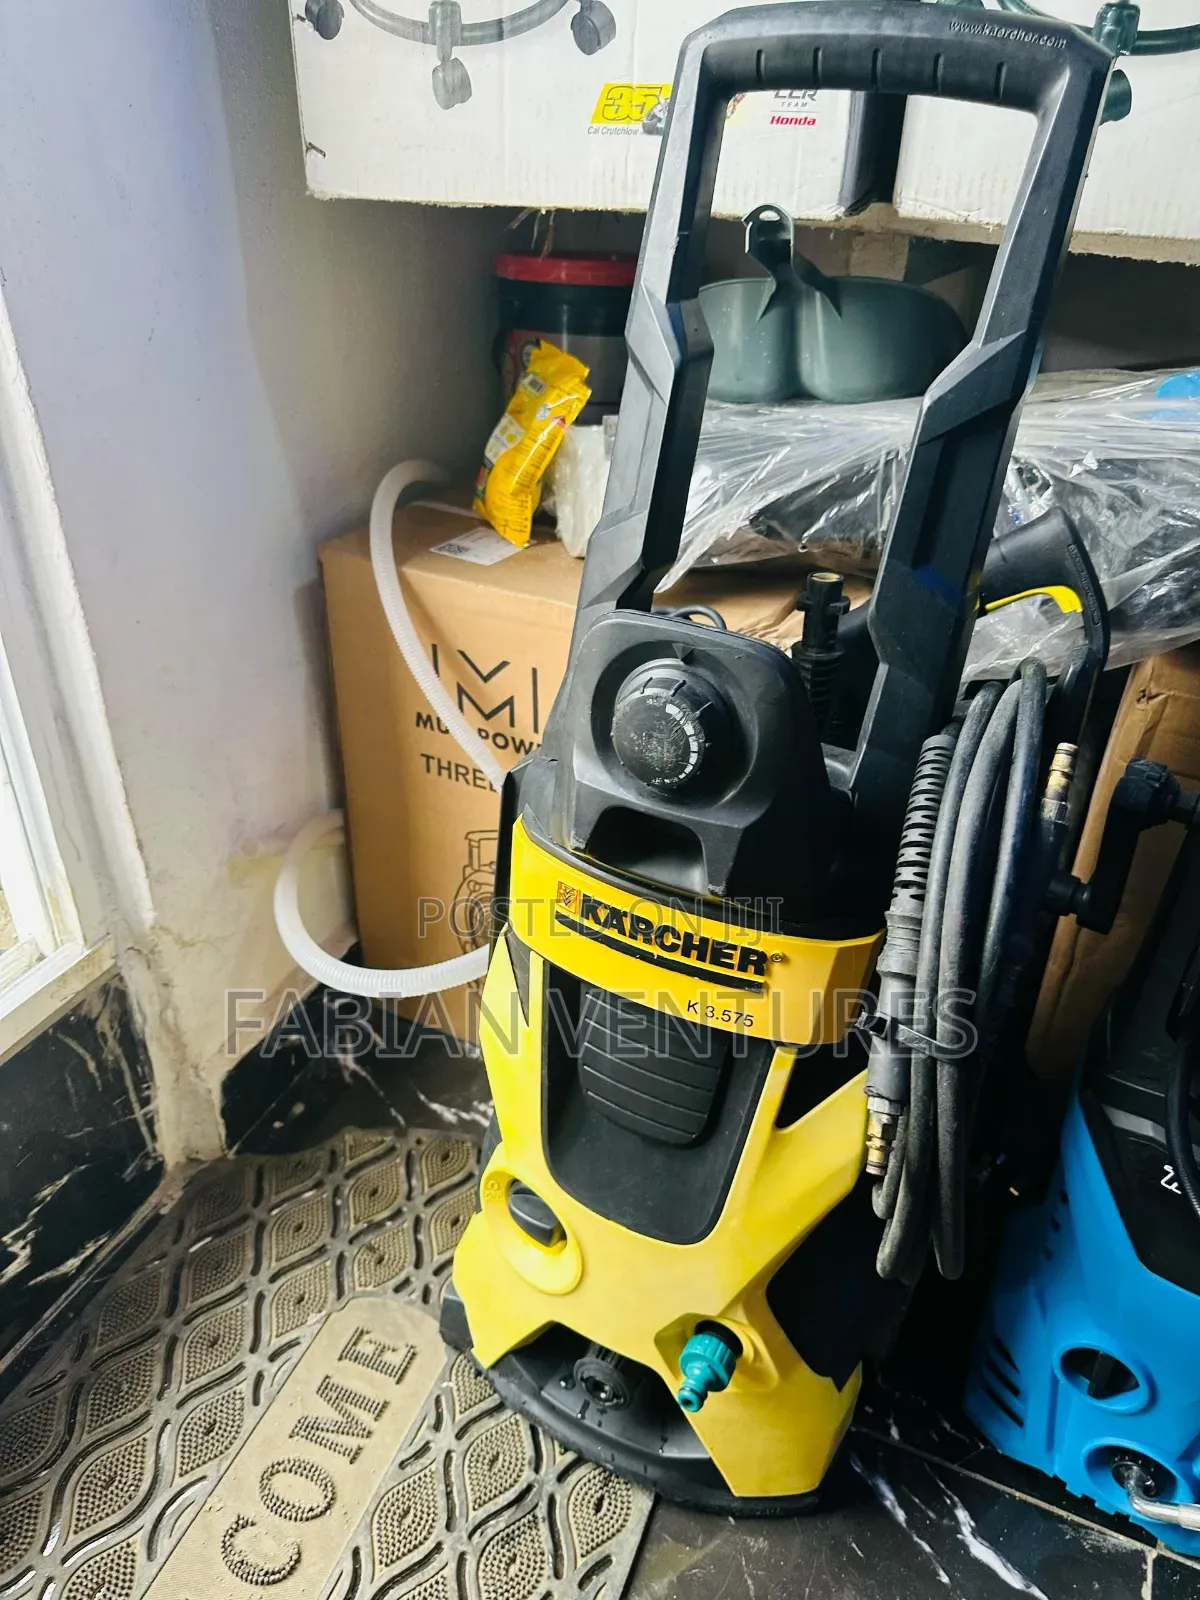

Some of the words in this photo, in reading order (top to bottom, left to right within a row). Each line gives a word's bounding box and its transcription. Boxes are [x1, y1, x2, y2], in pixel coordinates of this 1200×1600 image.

[602, 85, 663, 121] 35
[587, 126, 600, 135] Cal
[601, 126, 639, 136] Crutchlow
[770, 115, 816, 126] Honda
[686, 999, 699, 1015] K
[704, 1005, 755, 1028] 3.575
[220, 1326, 418, 1586] COME
